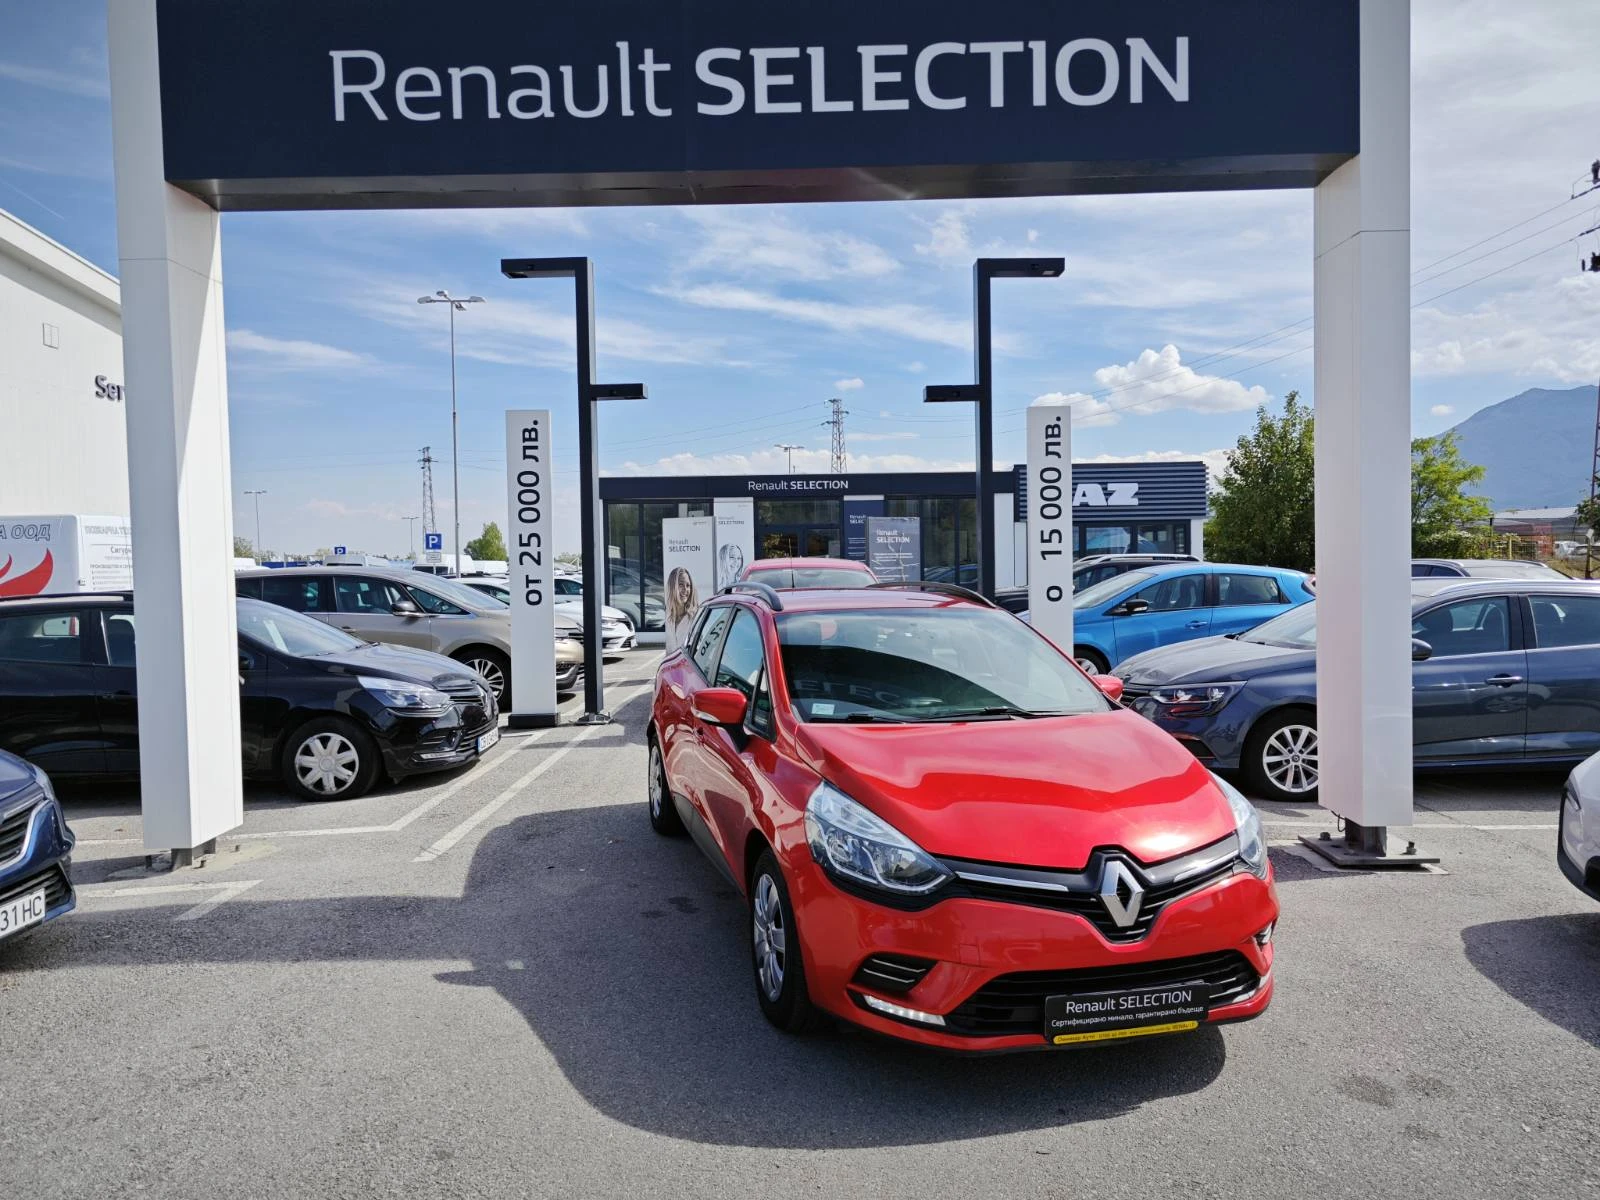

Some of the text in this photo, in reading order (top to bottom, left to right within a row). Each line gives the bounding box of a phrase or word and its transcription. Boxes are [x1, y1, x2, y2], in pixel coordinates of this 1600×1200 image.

[329, 36, 1191, 122] Renault SELECTION
[1044, 416, 1062, 459] лв.
[748, 480, 849, 491] Renault SELECTION
[1039, 466, 1062, 520] 000
[517, 419, 543, 606] от 25 000 лв.
[11, 523, 51, 542] ООД
[1040, 528, 1063, 561] 15
[1051, 1015, 1107, 1028] Сертифицирано
[1135, 1008, 1177, 1021] гарантирано
[1177, 1005, 1204, 1016] бъдеще
[1066, 990, 1192, 1014] Renault SELECTION
